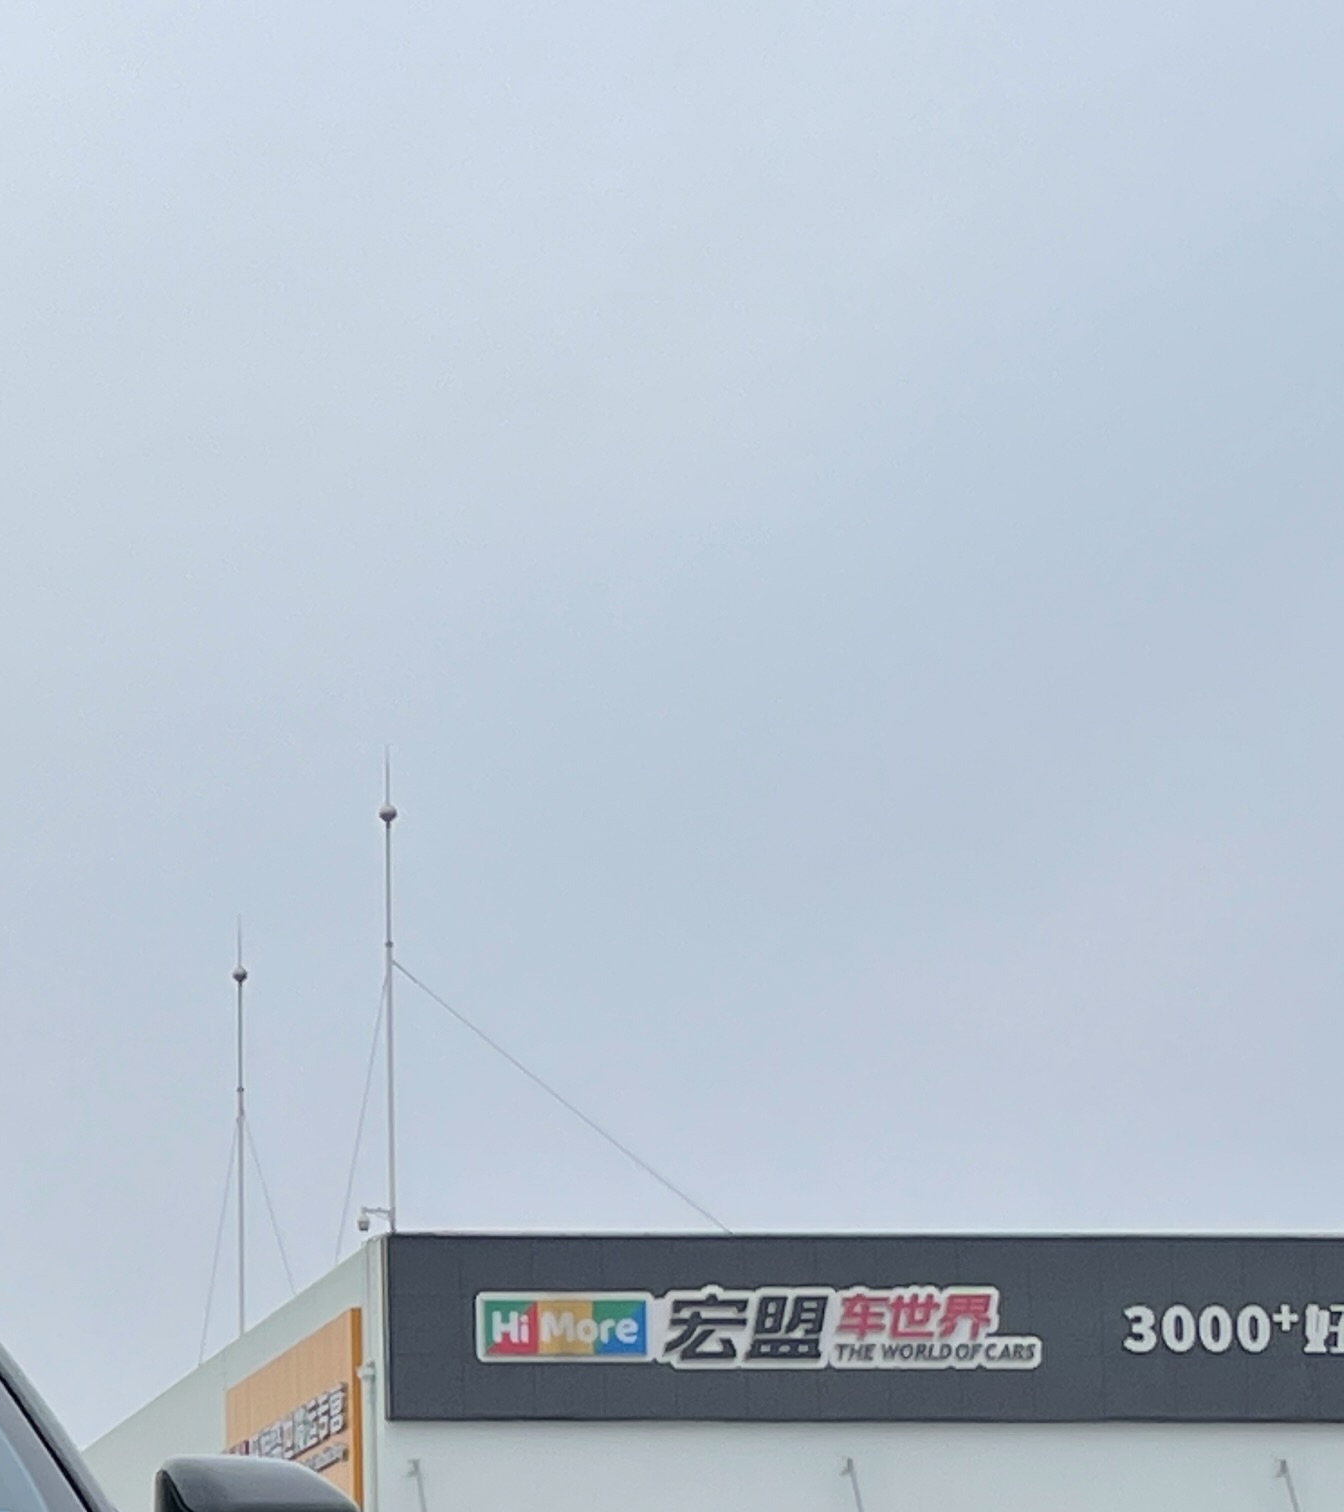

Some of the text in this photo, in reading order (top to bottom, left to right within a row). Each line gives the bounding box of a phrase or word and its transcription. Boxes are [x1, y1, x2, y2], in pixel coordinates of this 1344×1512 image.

[665, 1293, 829, 1360] 宏盟
[837, 1293, 992, 1341] 车世界
[835, 1343, 1037, 1361] THE WORLD OF CARS
